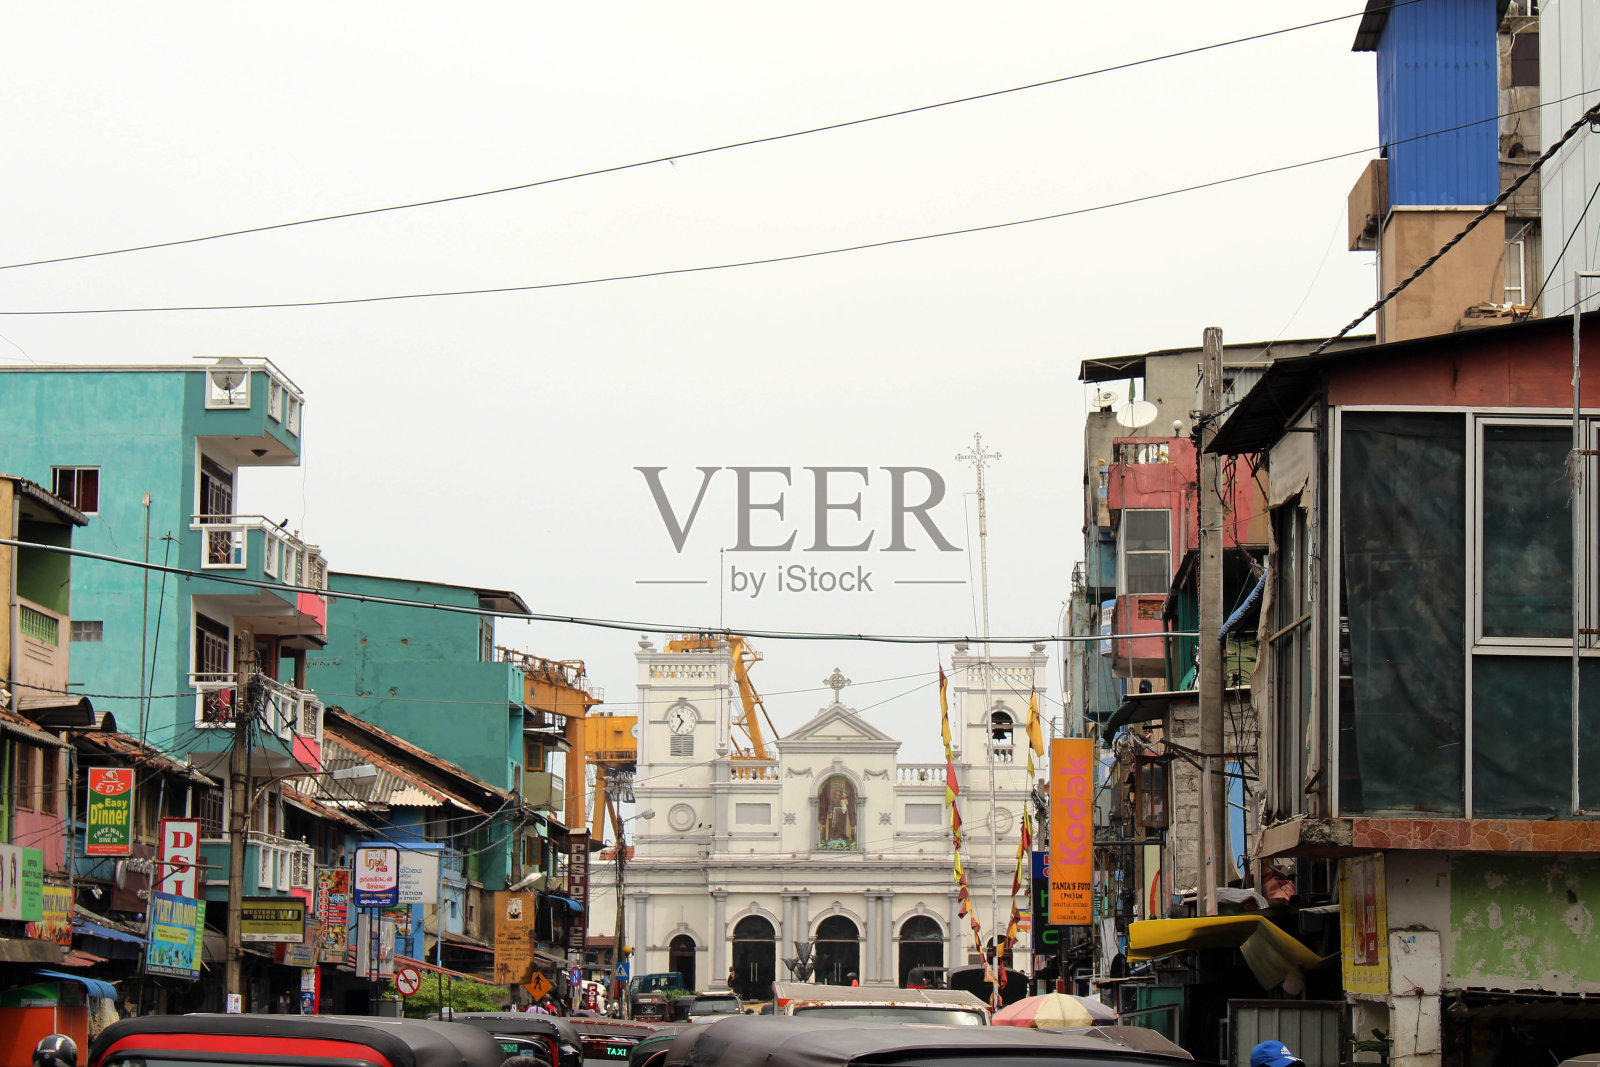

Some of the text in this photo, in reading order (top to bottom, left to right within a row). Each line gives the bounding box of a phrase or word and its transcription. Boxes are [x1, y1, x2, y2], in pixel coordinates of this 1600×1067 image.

[95, 782, 125, 793] EDS
[105, 798, 128, 809] Easy
[90, 803, 128, 826] Dinner
[1059, 754, 1087, 865] Kodak
[92, 827, 124, 839] TAKE WAY
[1052, 882, 1091, 890] TANIA'S FOTO
[588, 985, 596, 1006] POST
[606, 1047, 627, 1057] TAXI
